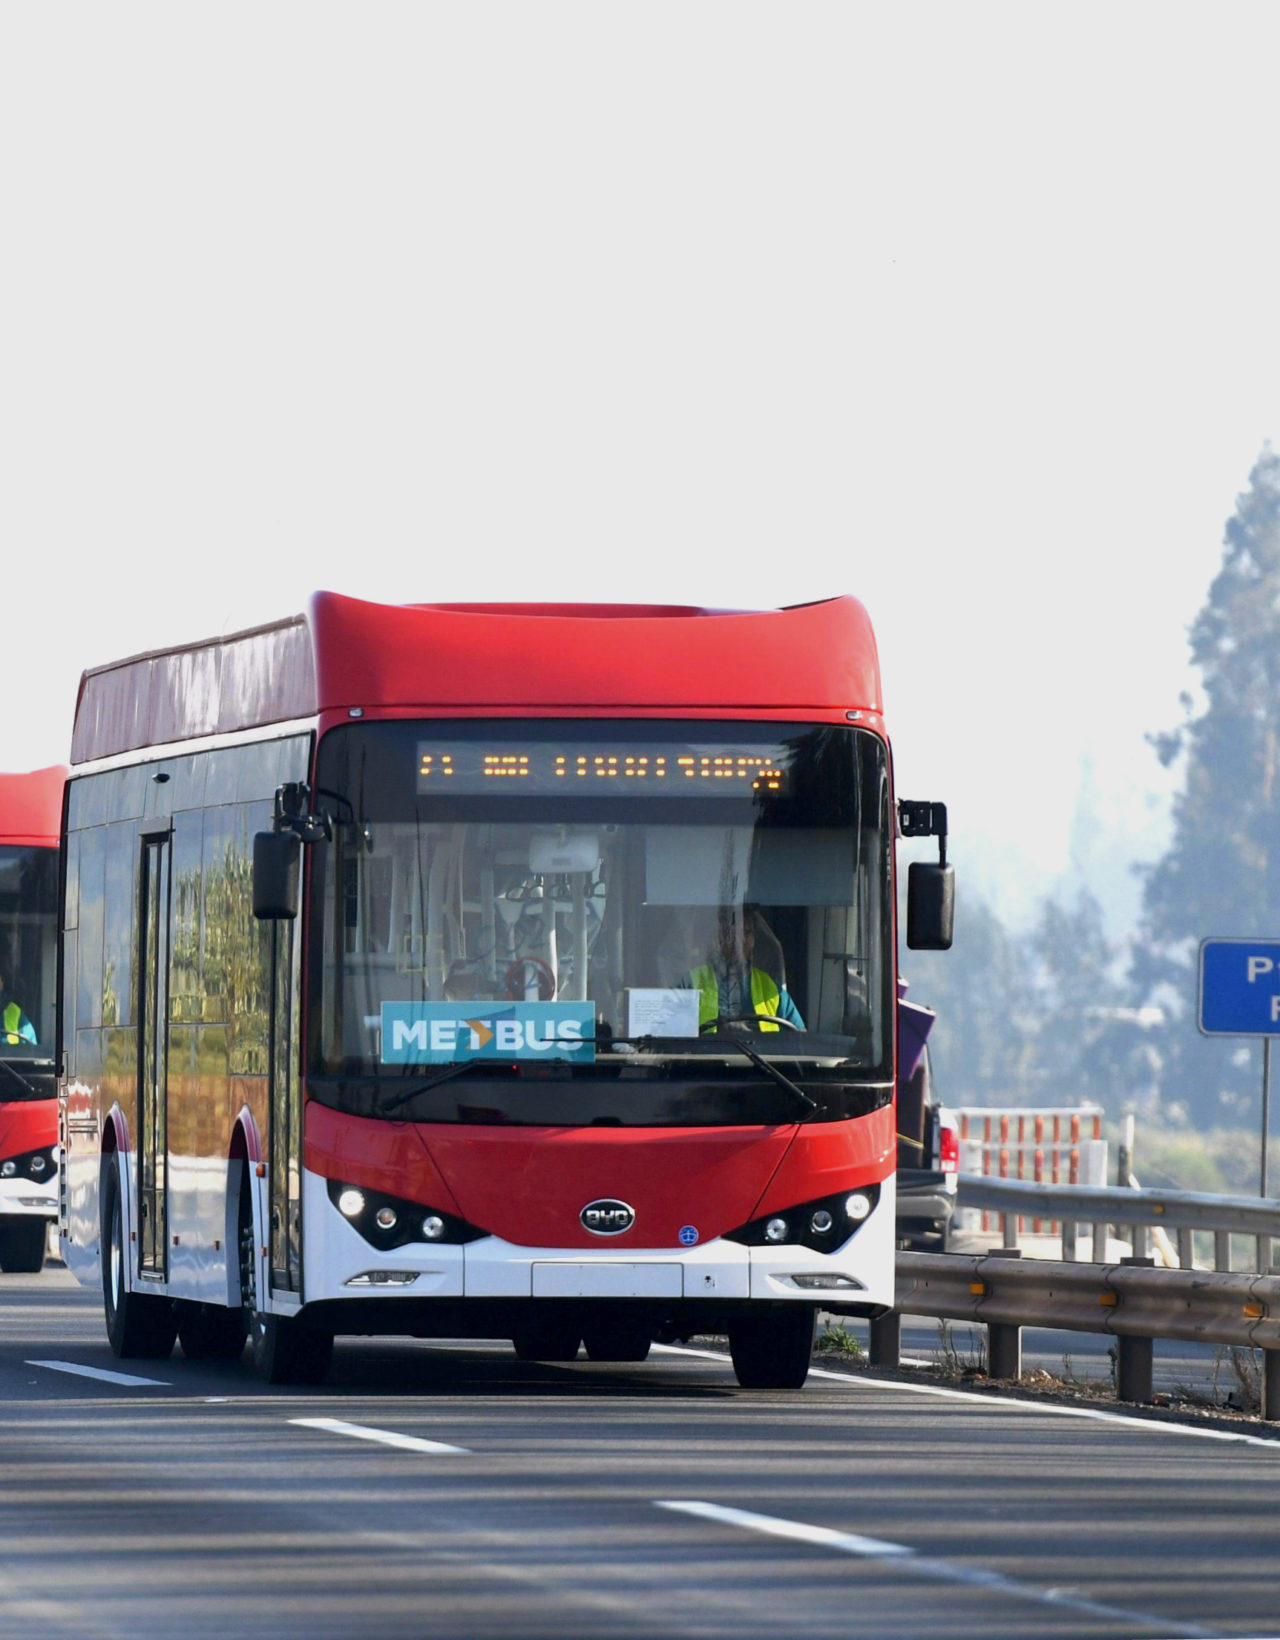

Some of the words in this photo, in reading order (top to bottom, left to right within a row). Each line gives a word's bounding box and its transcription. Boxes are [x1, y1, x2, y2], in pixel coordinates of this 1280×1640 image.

[1247, 956, 1280, 983] P
[392, 1019, 584, 1051] METBUS
[586, 1209, 629, 1225] BYD
